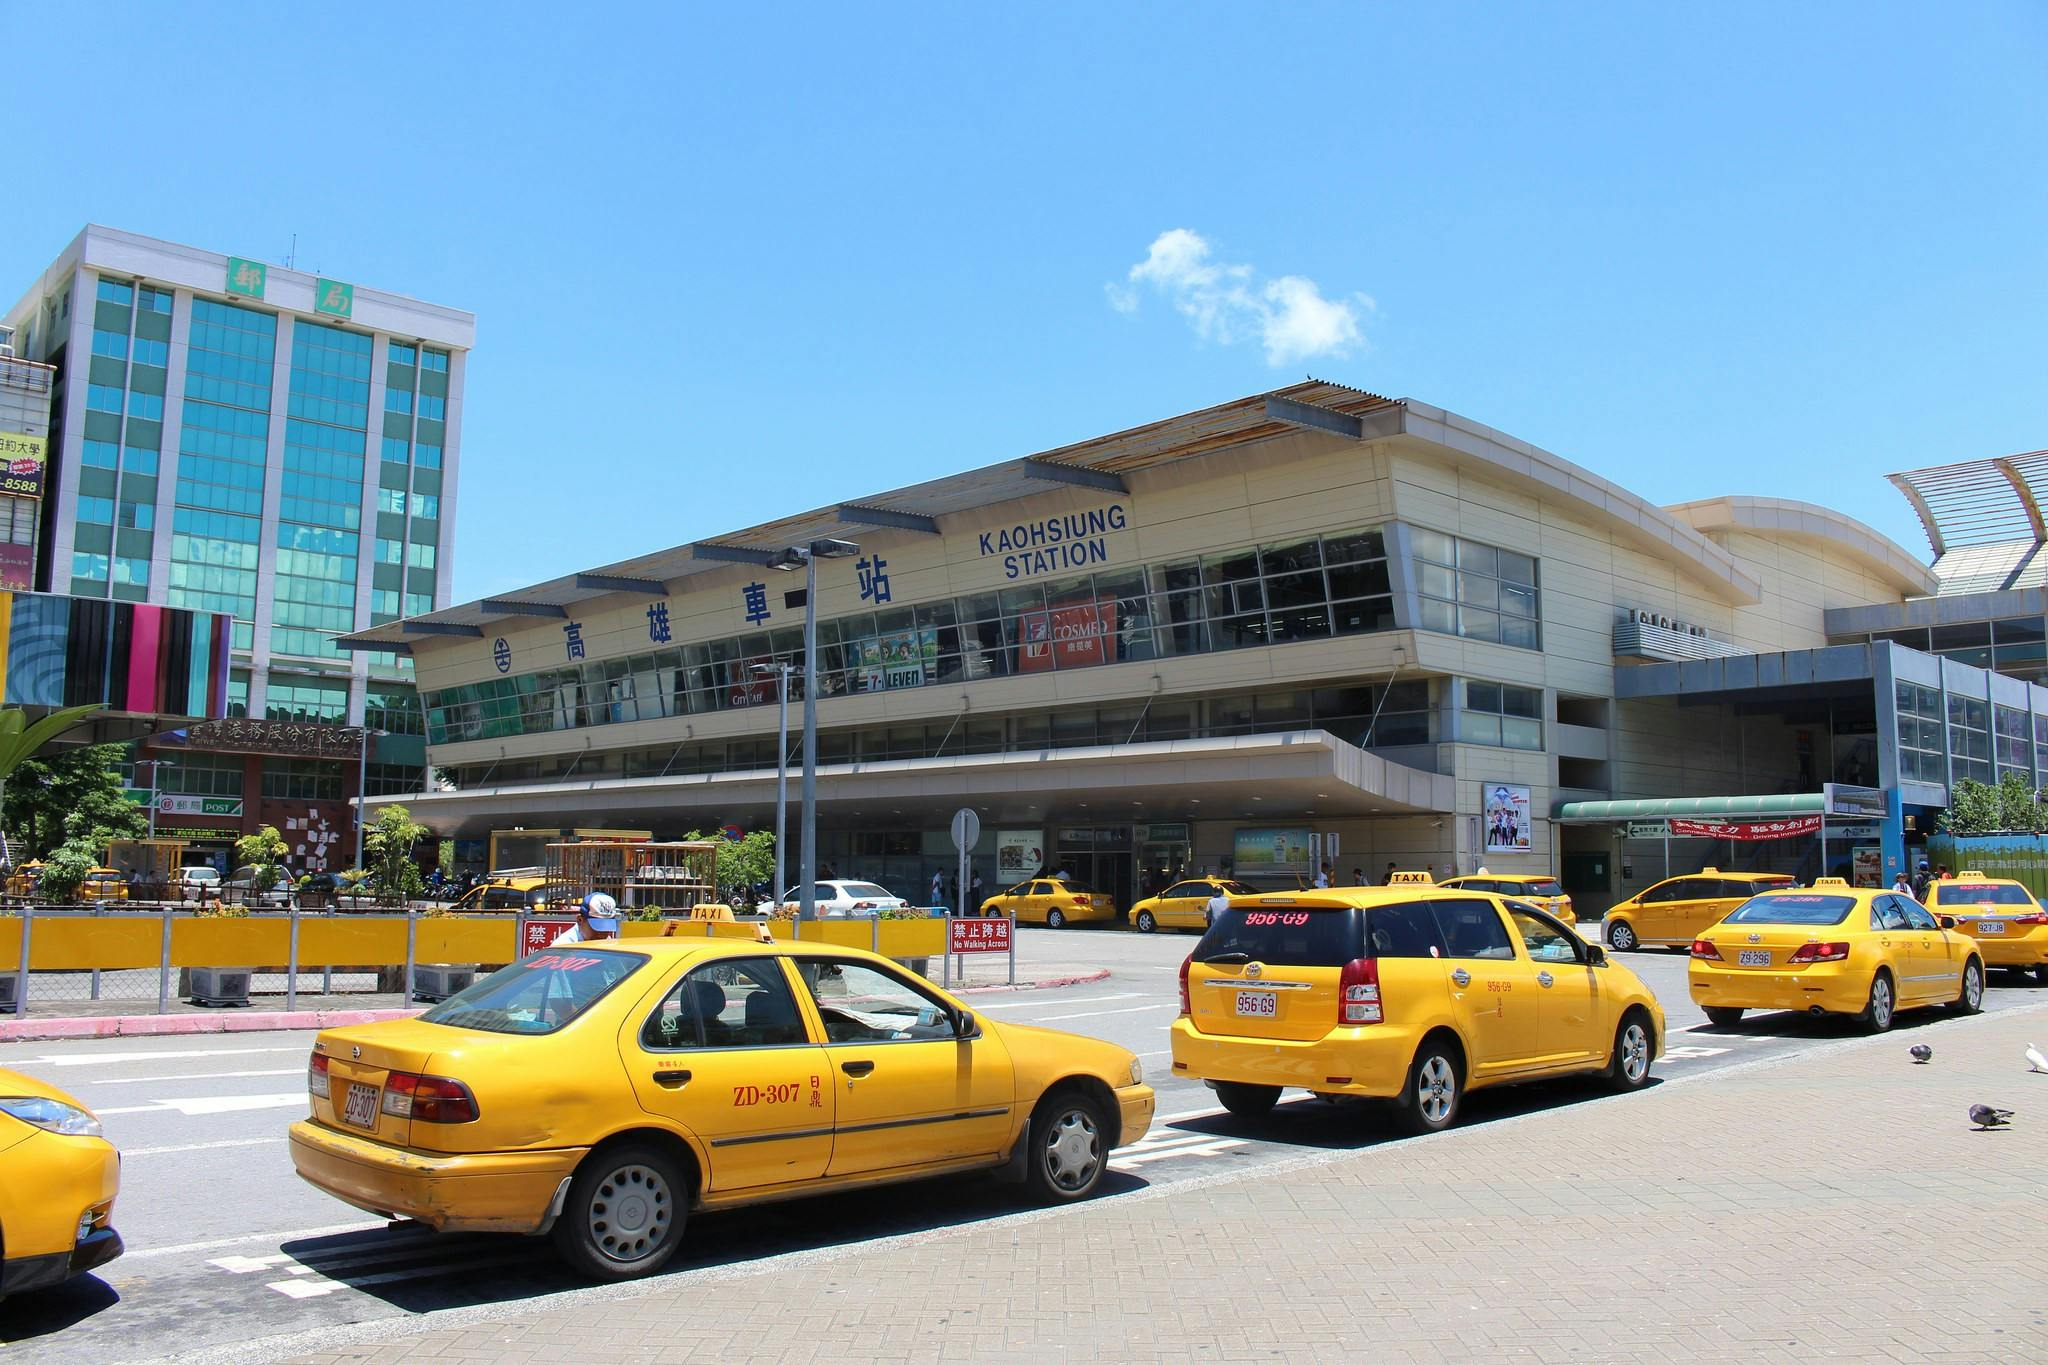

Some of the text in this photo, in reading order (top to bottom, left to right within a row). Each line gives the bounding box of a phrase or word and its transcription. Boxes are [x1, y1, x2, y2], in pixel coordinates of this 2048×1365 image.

[235, 263, 349, 312] 郵局
[979, 504, 1126, 556] KAOHSIUNG
[1004, 538, 1107, 579] STATION
[563, 554, 892, 662] 高雄車站
[1053, 620, 1108, 640] COSMED
[1068, 641, 1093, 653] 康是美
[206, 803, 229, 812] POST
[1753, 833, 1779, 841] Driving
[1394, 873, 1425, 882] TAXI
[694, 908, 721, 919] TAXI
[1245, 912, 1309, 926] 956-G9
[954, 922, 1008, 939] 禁止跨越
[1978, 924, 2004, 932] 927-J8
[954, 940, 1008, 950] No Walking Across
[524, 955, 603, 971] ZD-307
[1740, 953, 1770, 965] Z9-296
[1487, 981, 1512, 993] 956-G9
[1237, 996, 1276, 1013] 956-G9
[733, 1083, 801, 1107] ZD-307
[345, 1091, 377, 1121] ZD-307
